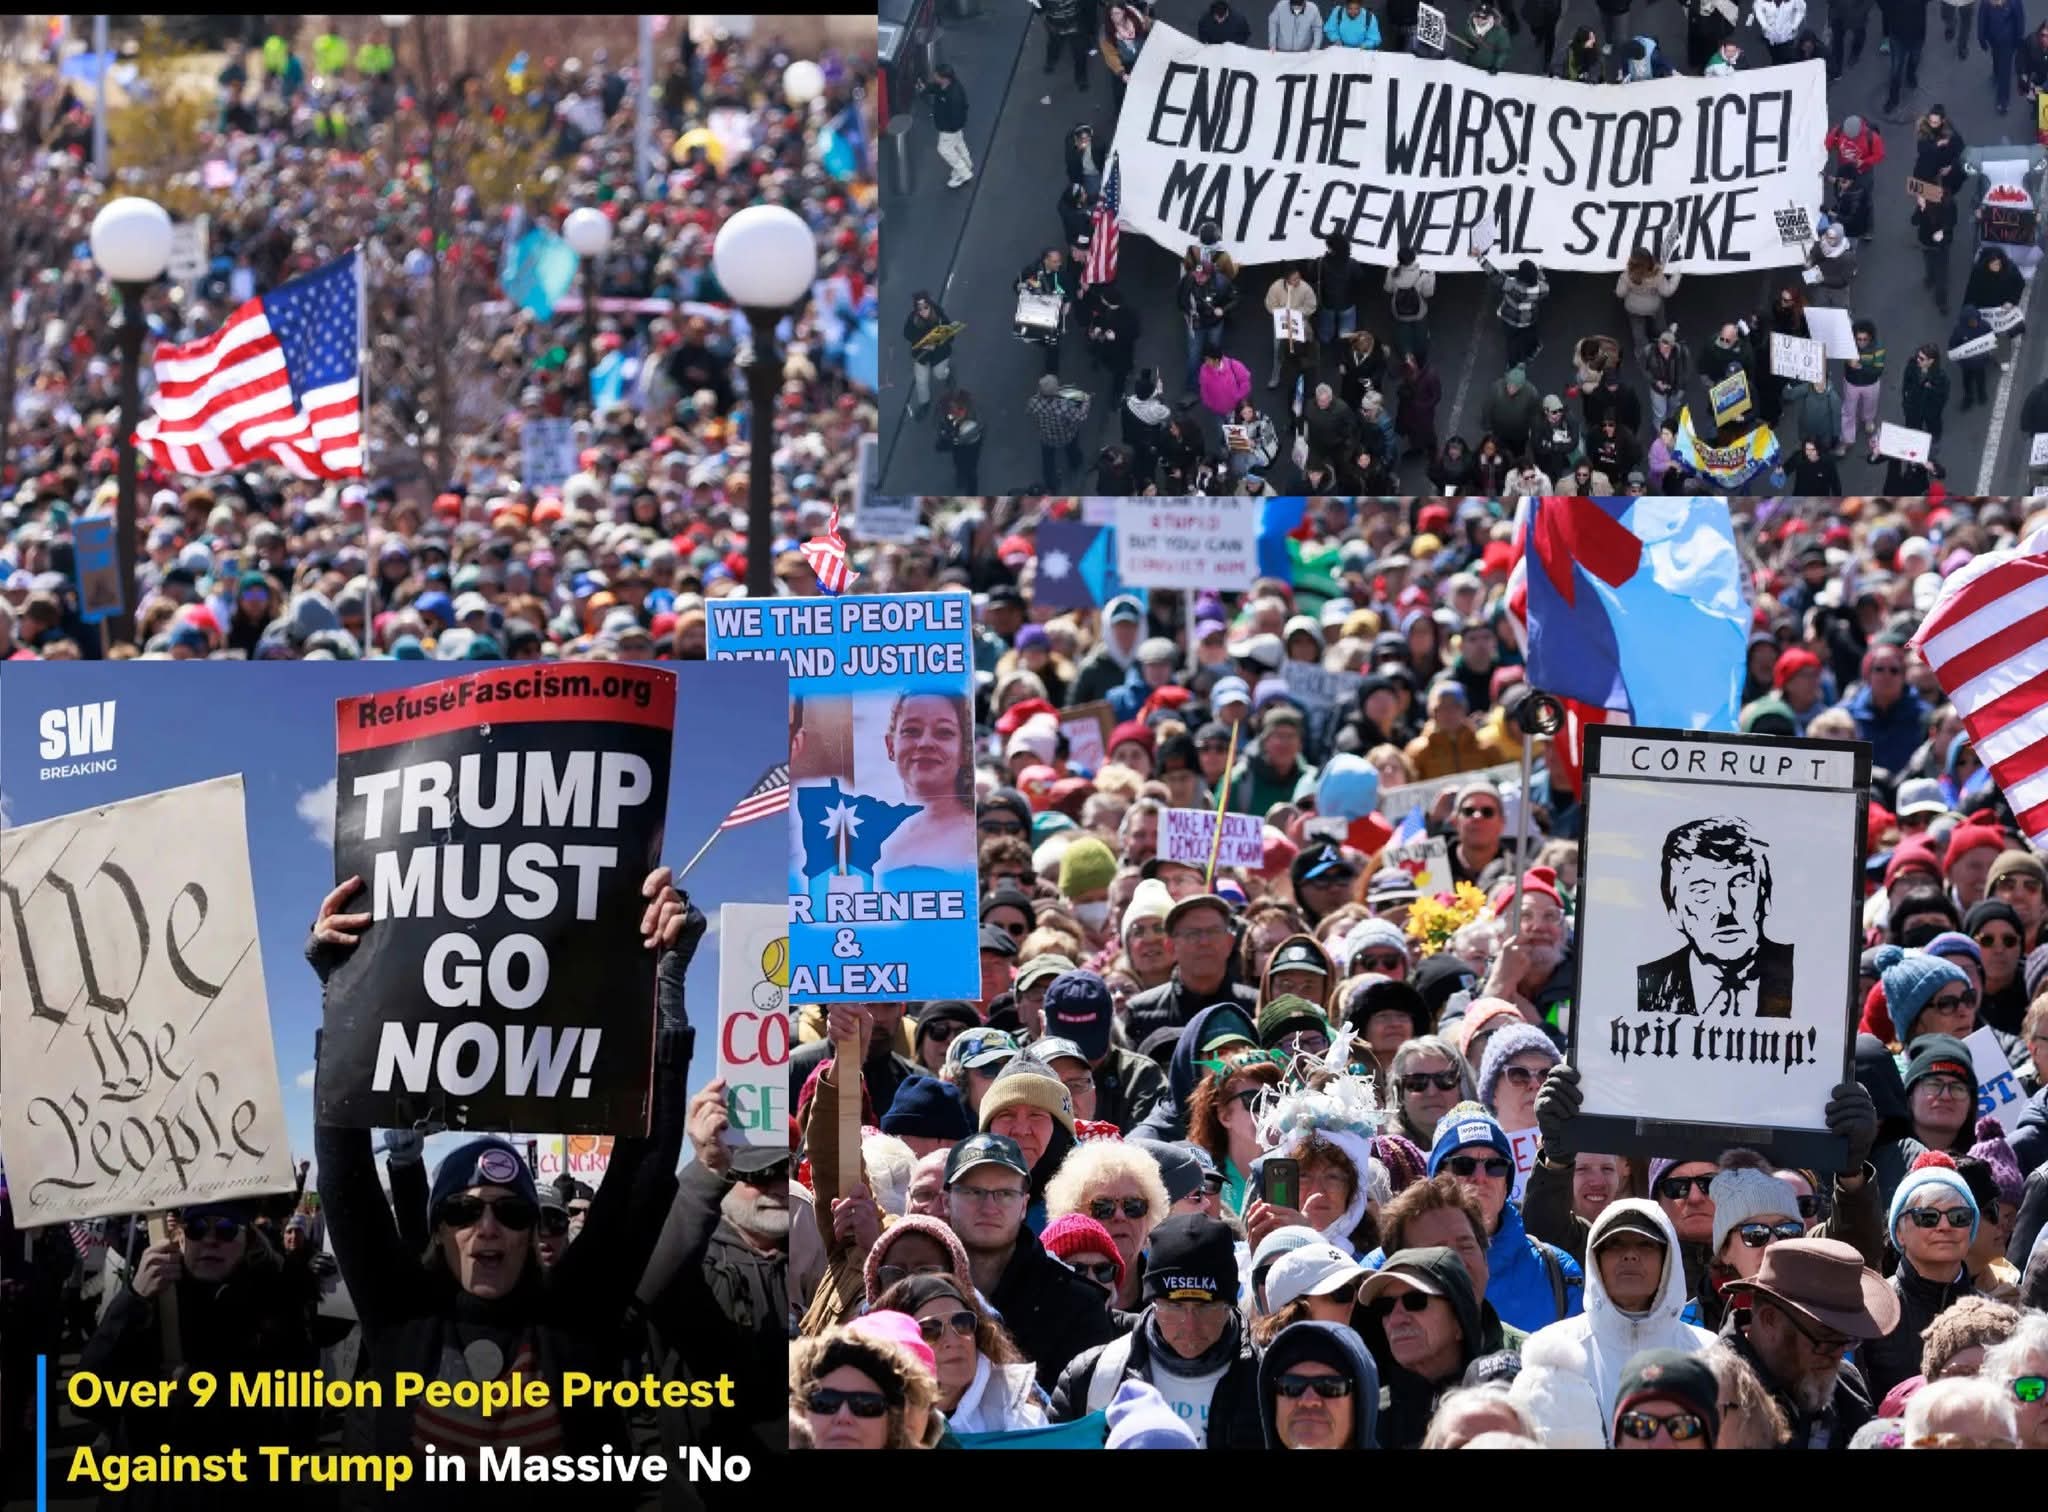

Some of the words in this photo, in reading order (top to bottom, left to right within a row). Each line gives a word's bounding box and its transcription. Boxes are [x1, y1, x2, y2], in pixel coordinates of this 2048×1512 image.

[1147, 61, 1258, 153] END
[1273, 74, 1372, 168] THE
[1386, 78, 1536, 178] WARS!
[1544, 106, 1682, 191] STOP
[1690, 90, 1792, 184] ICE!
[1157, 160, 1274, 242] MAY
[1310, 180, 1543, 256] GENERAL
[1563, 186, 1758, 262] STRIKE
[713, 607, 762, 638] WE
[770, 605, 833, 636] THE
[841, 600, 964, 633] PEOPLE
[841, 643, 965, 676] JUSTICE
[358, 670, 652, 729] RefuseFascism.org
[1631, 746, 1826, 780] CORRUPT
[354, 751, 652, 840] TRUMP
[372, 842, 618, 921] MUST
[826, 890, 965, 922] RENEE
[0, 838, 255, 1053] We
[423, 932, 550, 1010] GO
[832, 928, 863, 959] &
[789, 963, 908, 995] ALEX!
[371, 1021, 602, 1098] NOW!
[722, 1011, 789, 1066] CO
[1692, 1020, 1817, 1075] trump!
[727, 1083, 787, 1132] GE
[28, 1071, 271, 1206] People
